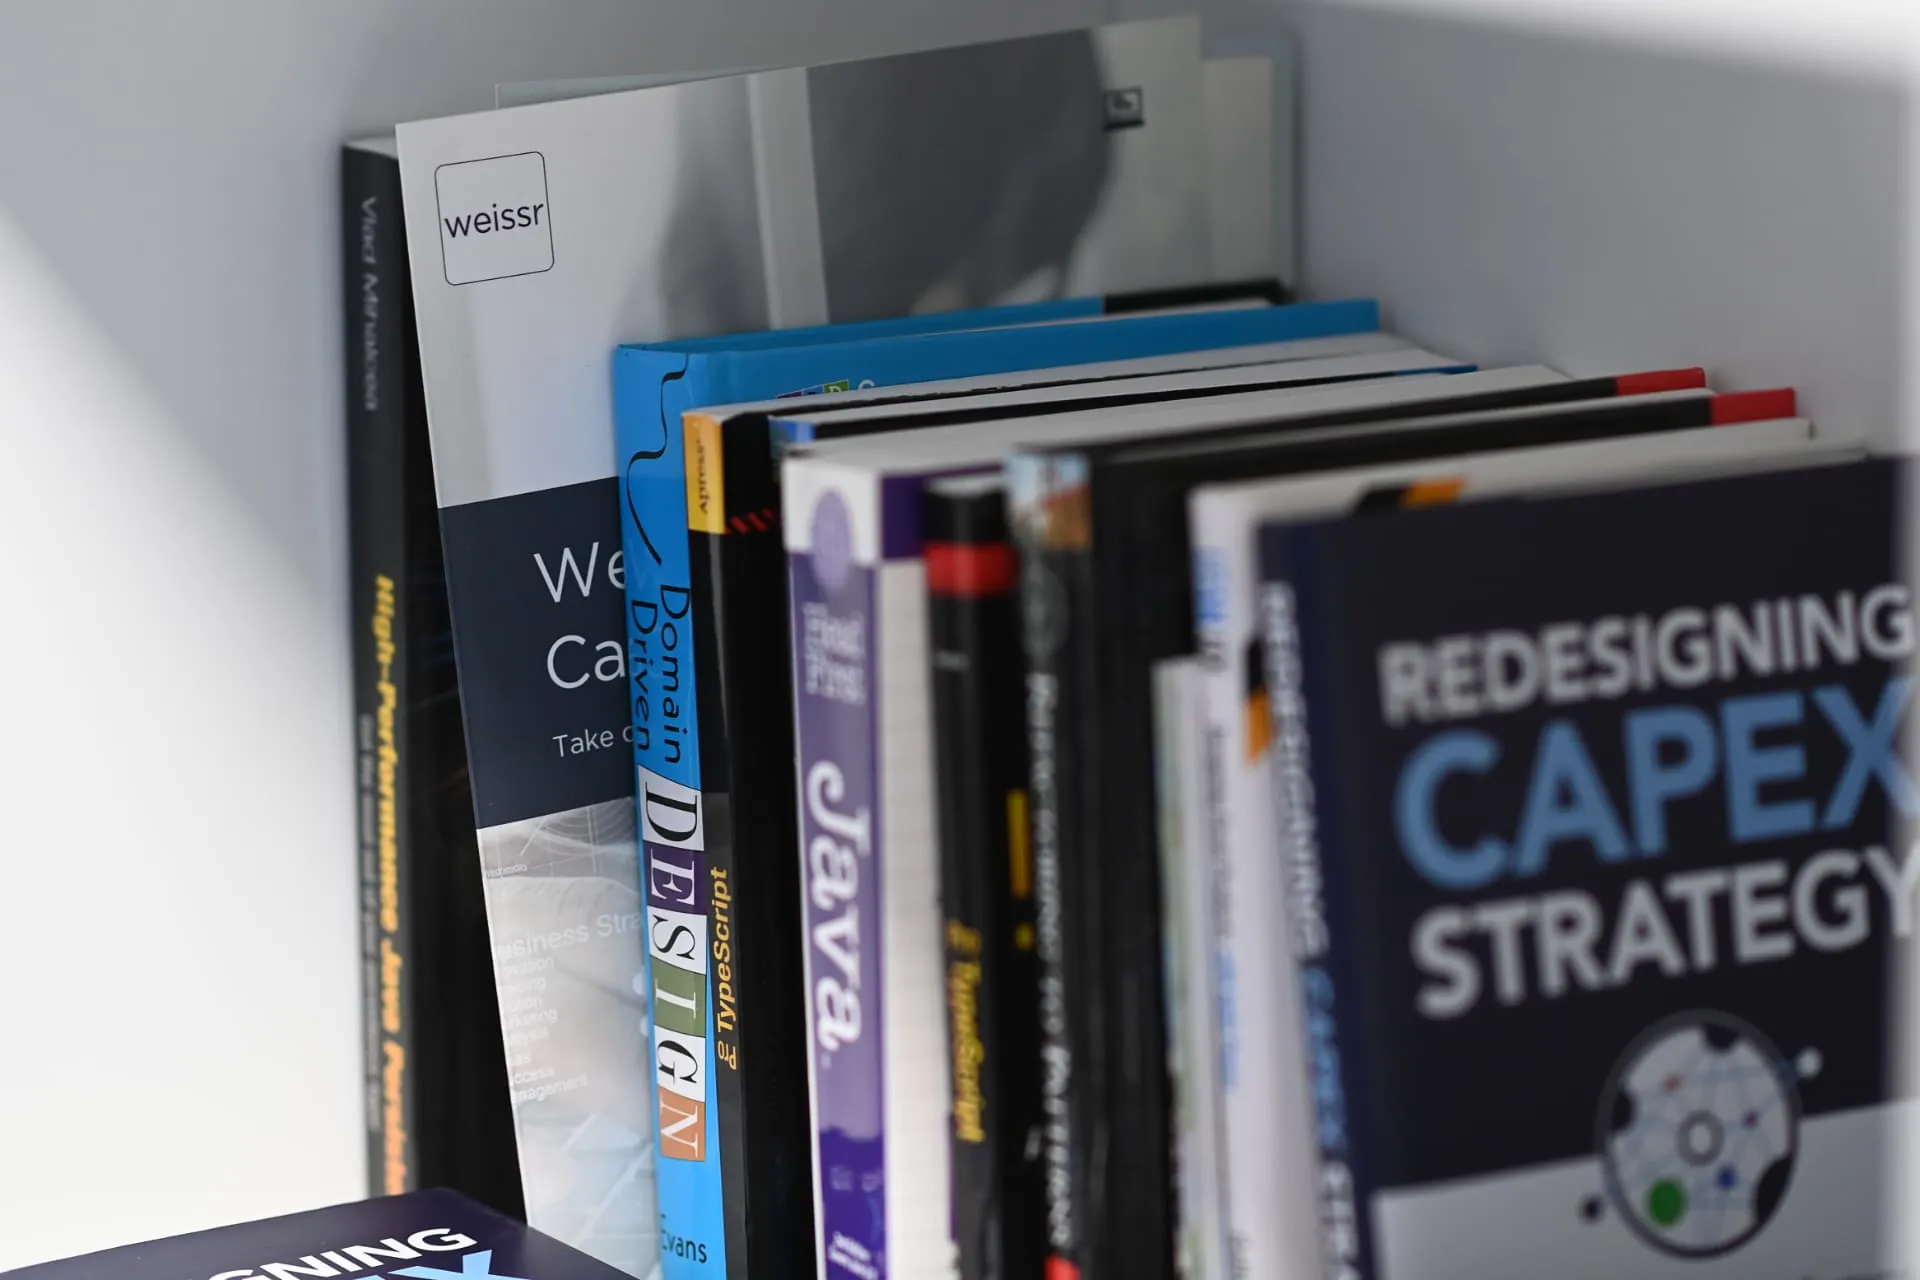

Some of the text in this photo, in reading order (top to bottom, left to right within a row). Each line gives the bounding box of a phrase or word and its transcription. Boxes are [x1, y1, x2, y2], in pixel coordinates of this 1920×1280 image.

[444, 202, 544, 238] weissr
[546, 634, 627, 689] Ca
[631, 599, 658, 751] Driven
[660, 584, 691, 763] Domain
[1377, 584, 1917, 727] REDESIGNING
[552, 728, 614, 758] Take
[1394, 675, 1920, 891] CAPEX
[710, 866, 737, 1033] TypeScript
[807, 760, 872, 1051] Java
[1410, 845, 1920, 1019] STRATEGY
